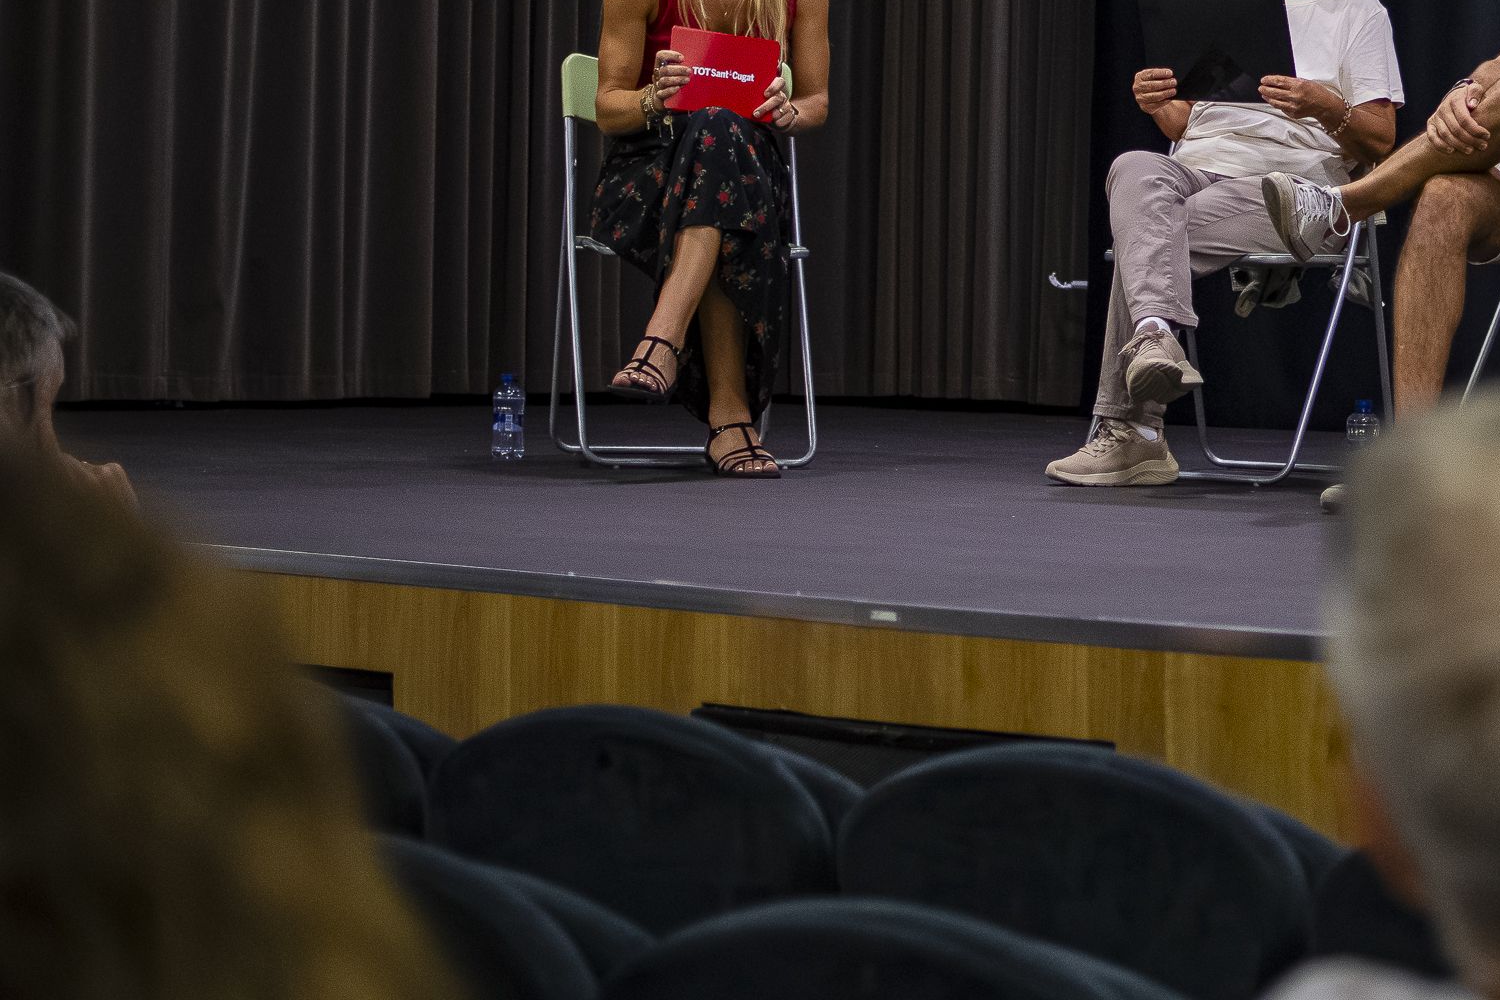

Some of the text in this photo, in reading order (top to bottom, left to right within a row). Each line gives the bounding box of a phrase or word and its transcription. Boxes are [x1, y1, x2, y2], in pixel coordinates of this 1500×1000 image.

[692, 66, 755, 83] TOT Sant Cugat
